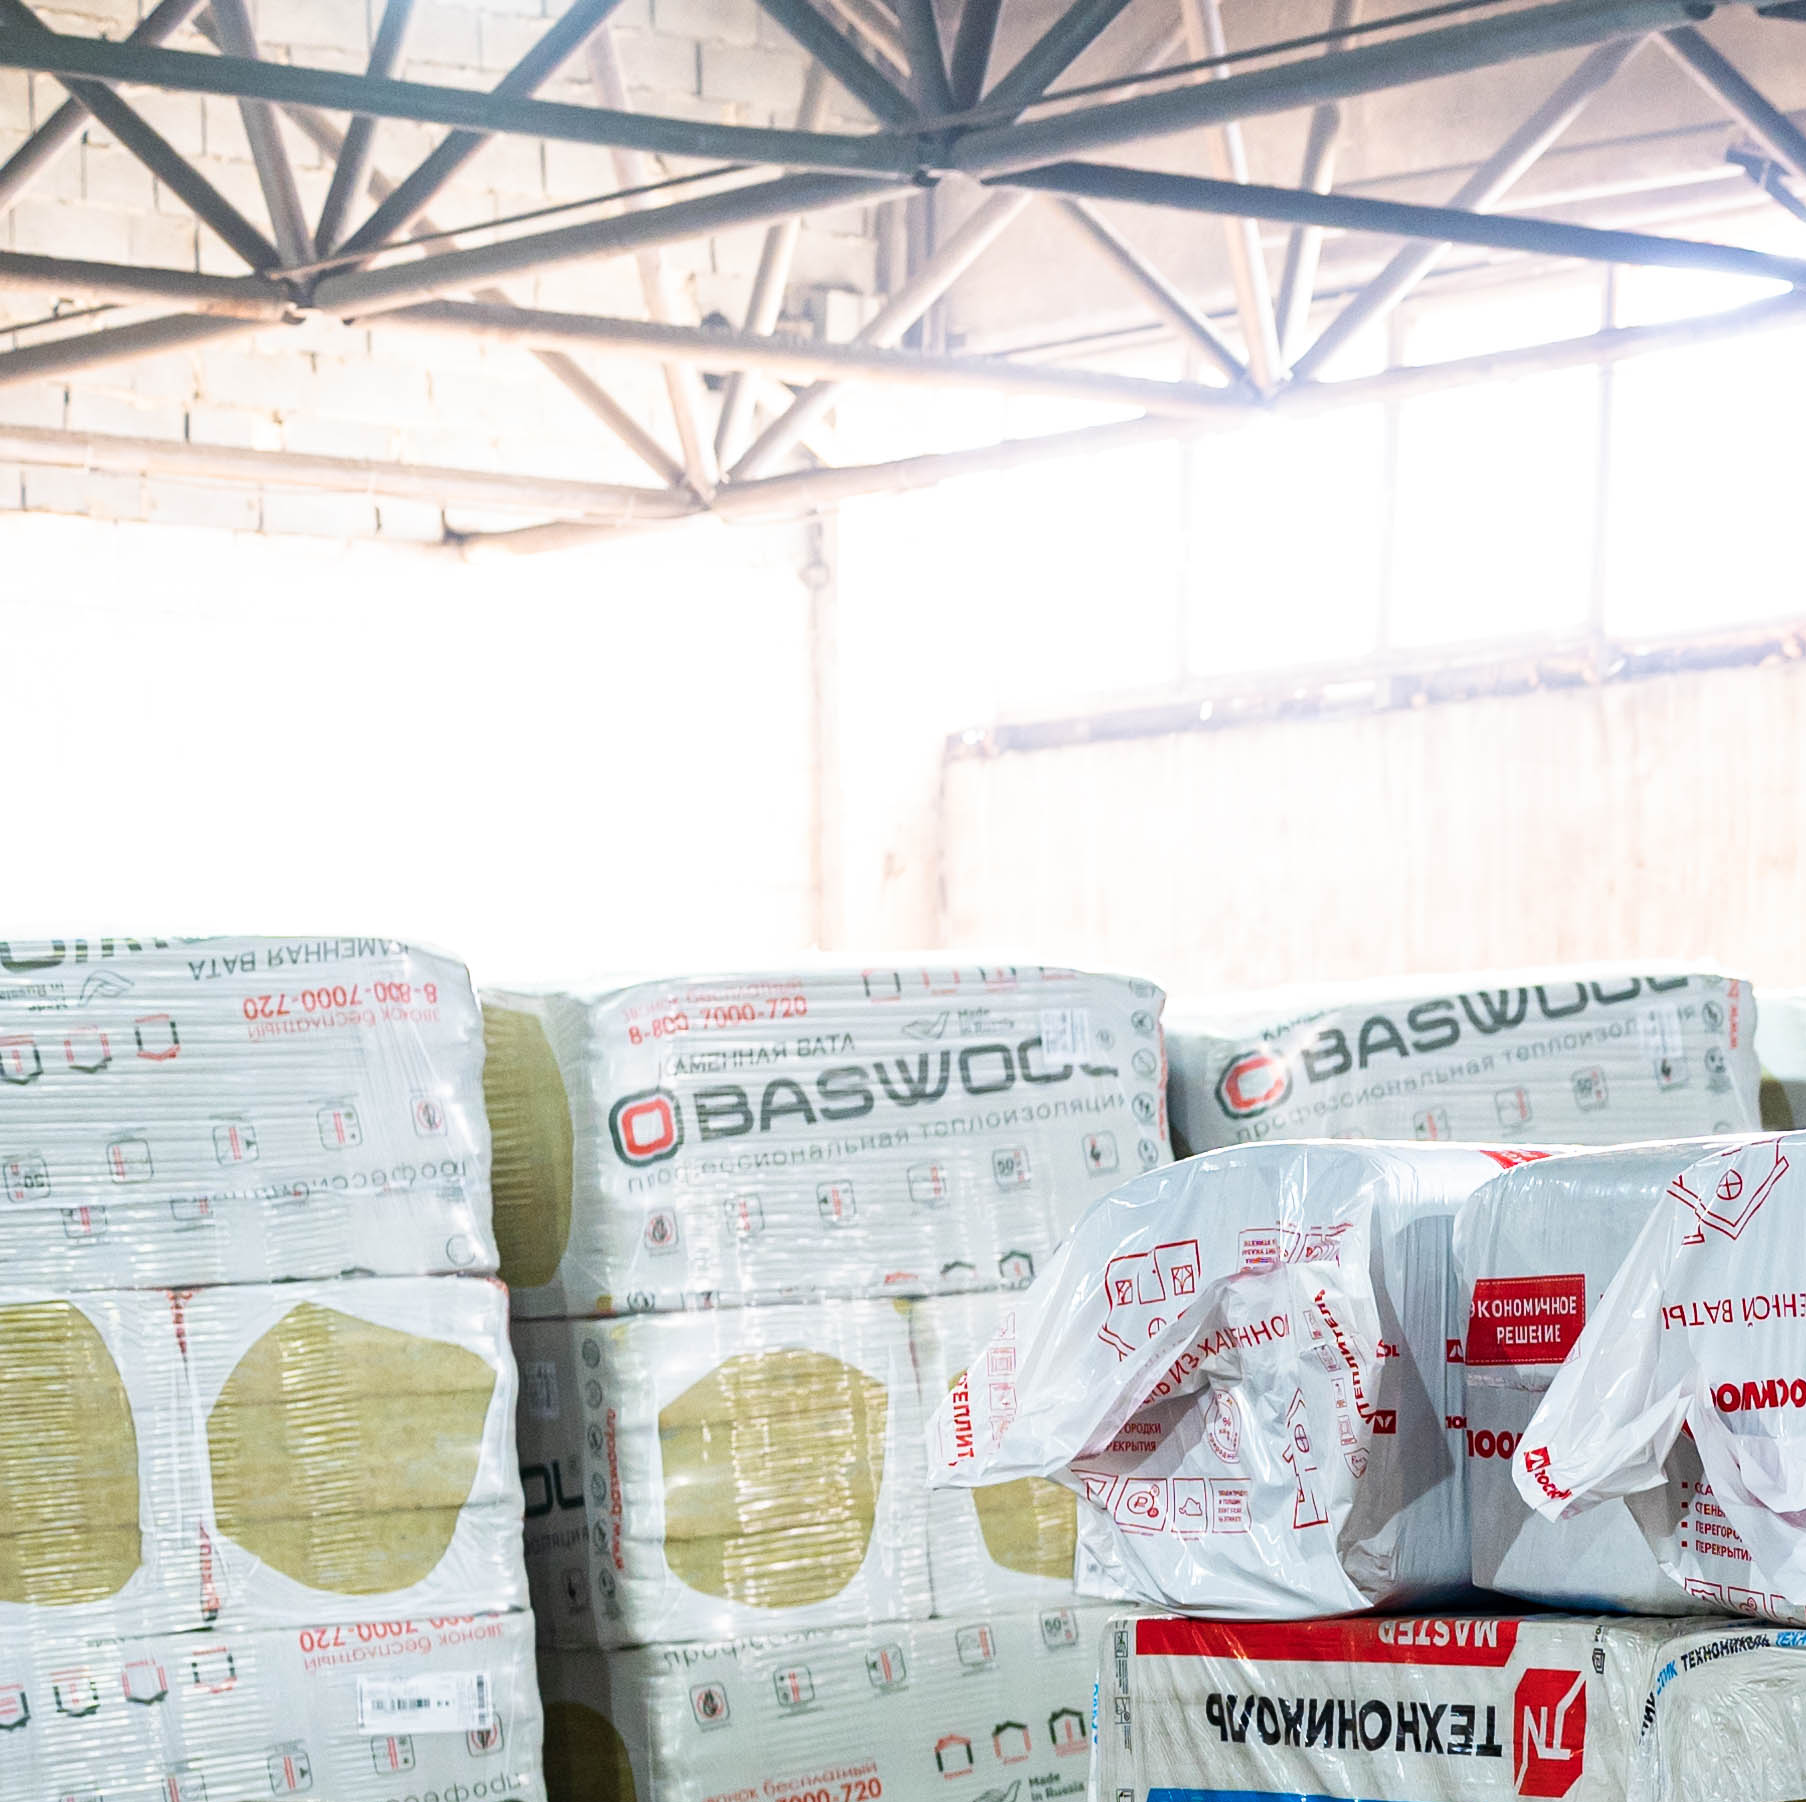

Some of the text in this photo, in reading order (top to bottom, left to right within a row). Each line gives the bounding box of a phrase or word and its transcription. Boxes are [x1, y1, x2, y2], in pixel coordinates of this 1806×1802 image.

[187, 949, 257, 983] ВАТА
[241, 981, 439, 1021] 8-800-7000-720
[670, 1043, 788, 1077] АМЕННАЯ
[1660, 1298, 1734, 1331] ВАТЫ
[1495, 1324, 1562, 1346] РЕШЕНИЕ
[1205, 1691, 1503, 1759] ТЕХНОНИКОЛЬ
